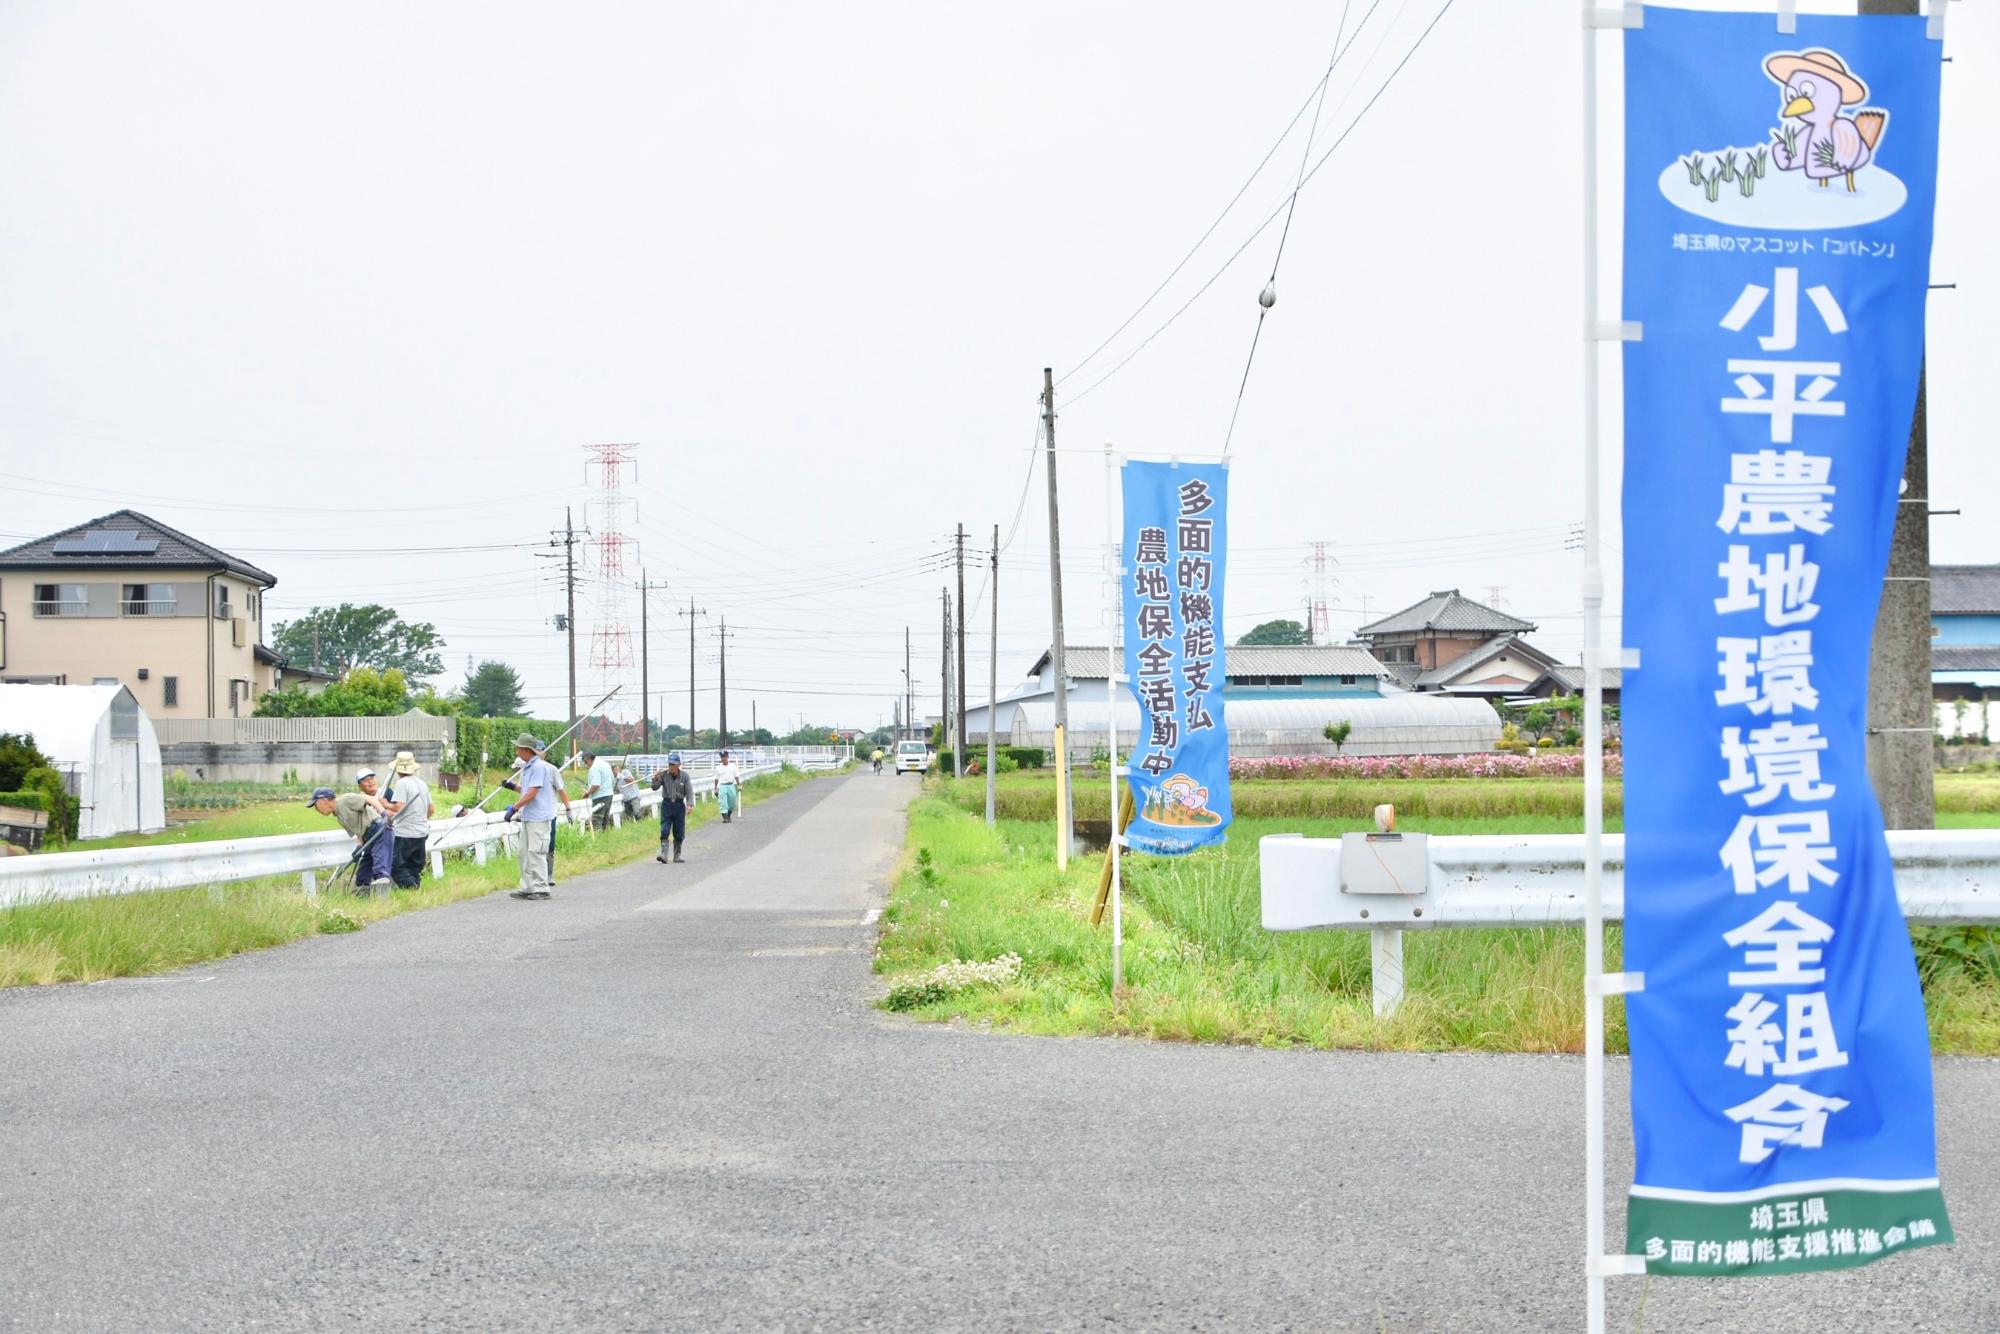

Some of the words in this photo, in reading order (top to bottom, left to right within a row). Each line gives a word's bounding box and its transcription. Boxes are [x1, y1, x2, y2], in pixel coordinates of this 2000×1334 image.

[1135, 526, 1179, 777] 農地保全活動中
[1177, 478, 1216, 735] 多面的機能支払
[1713, 267, 1851, 1164] 小平農地環境保全組合
[1750, 1198, 1828, 1231] 埼玉県
